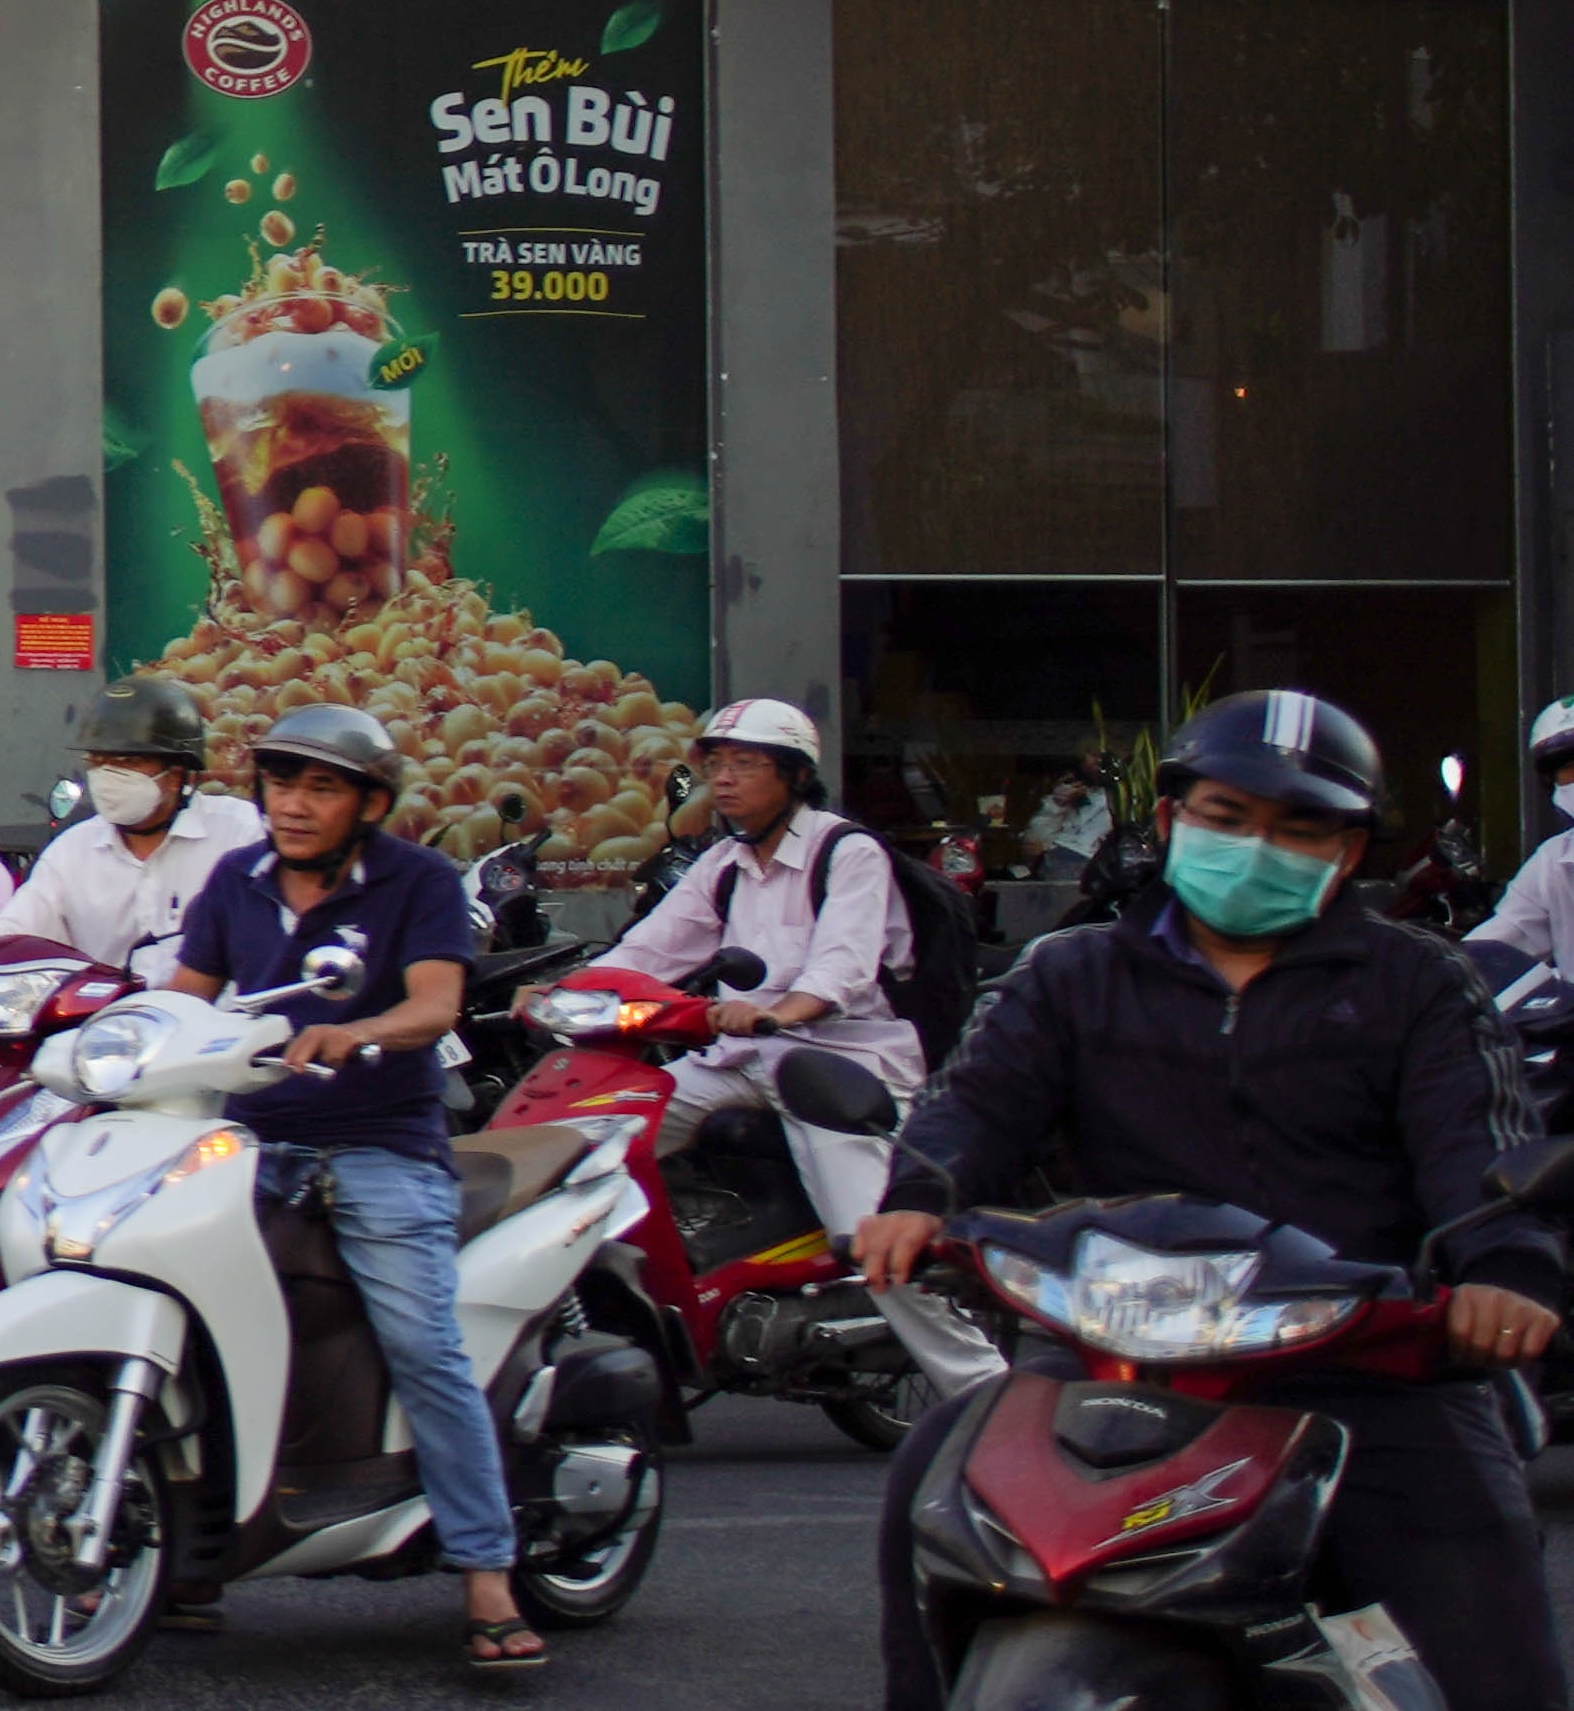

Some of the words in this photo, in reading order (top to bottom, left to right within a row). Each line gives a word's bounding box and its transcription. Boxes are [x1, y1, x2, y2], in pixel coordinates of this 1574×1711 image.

[204, 66, 291, 92] COFFEE
[430, 91, 551, 154] Sen
[565, 86, 676, 162] Bùi
[442, 153, 524, 204] Mát
[528, 147, 561, 193] Ô
[563, 157, 661, 216] Long
[462, 237, 514, 264] TRÀ
[517, 242, 567, 265] SEN
[571, 238, 642, 266] VÀNG
[489, 270, 609, 301] 39.000
